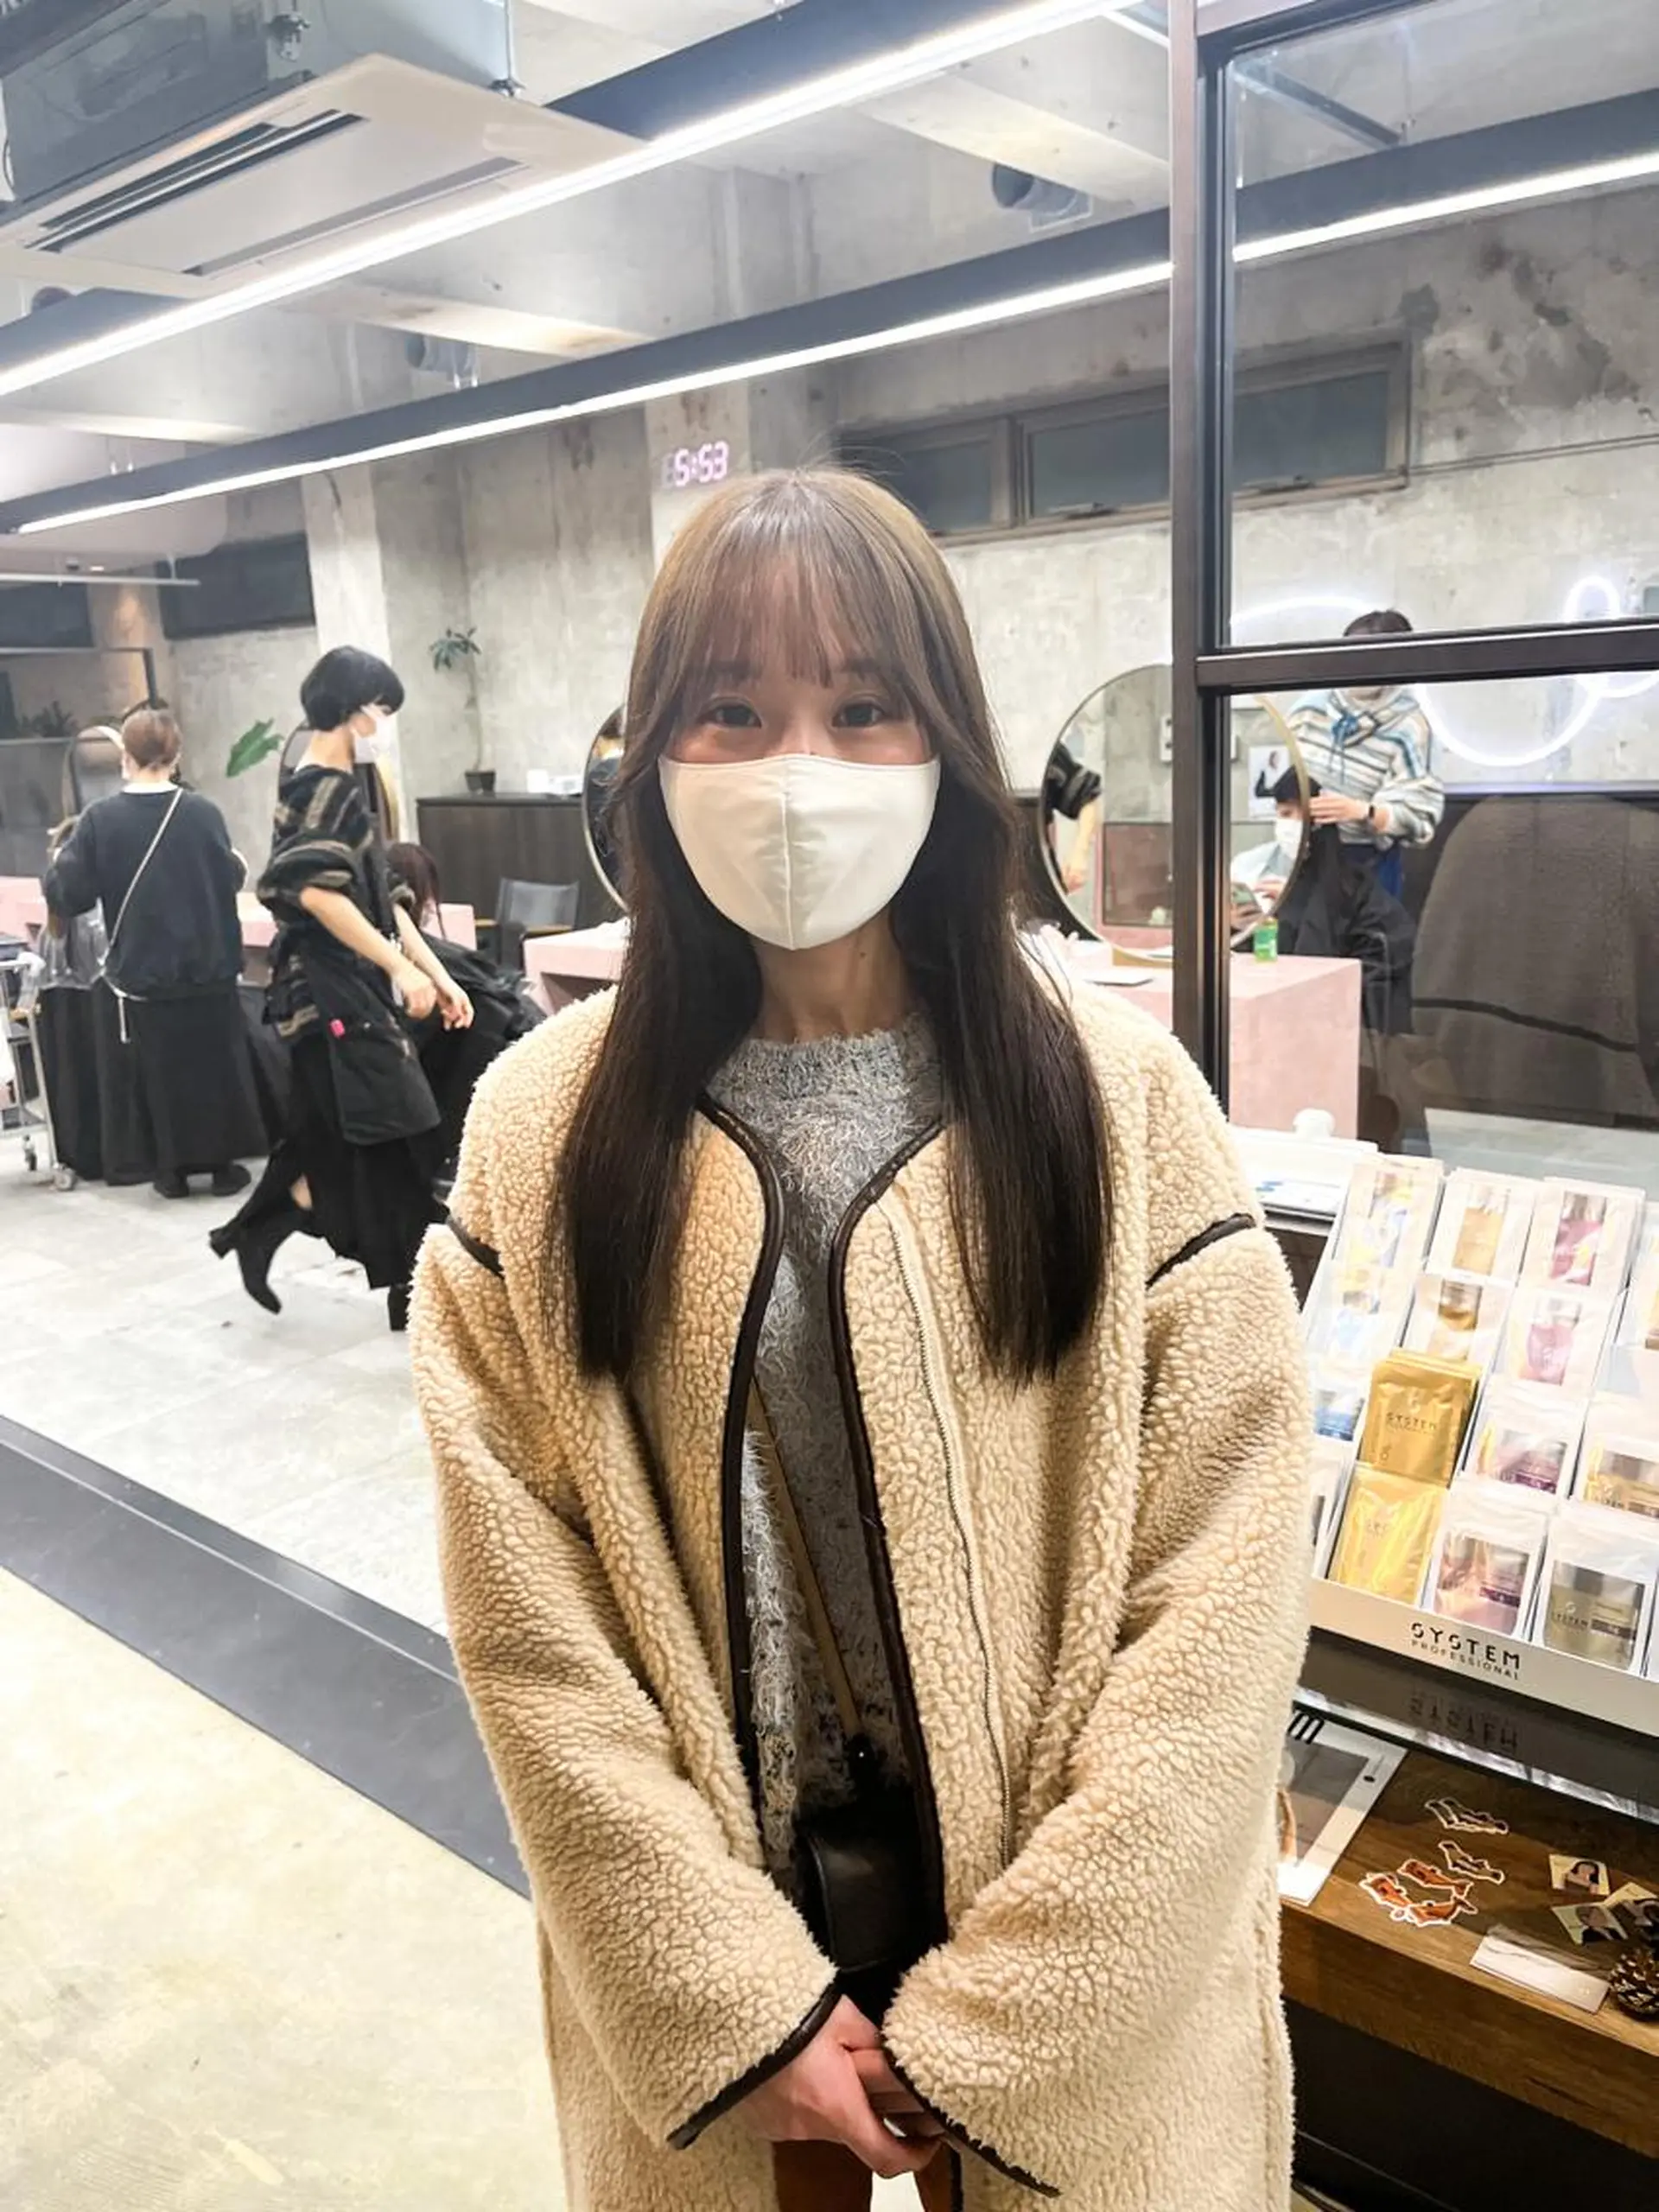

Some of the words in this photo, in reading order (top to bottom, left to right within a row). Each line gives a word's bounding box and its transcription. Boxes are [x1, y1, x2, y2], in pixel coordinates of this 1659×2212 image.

[675, 441, 729, 486] 5:53
[1411, 1623, 1520, 1669] SYSTEM
[1411, 1639, 1519, 1681] PROFESSIONAL
